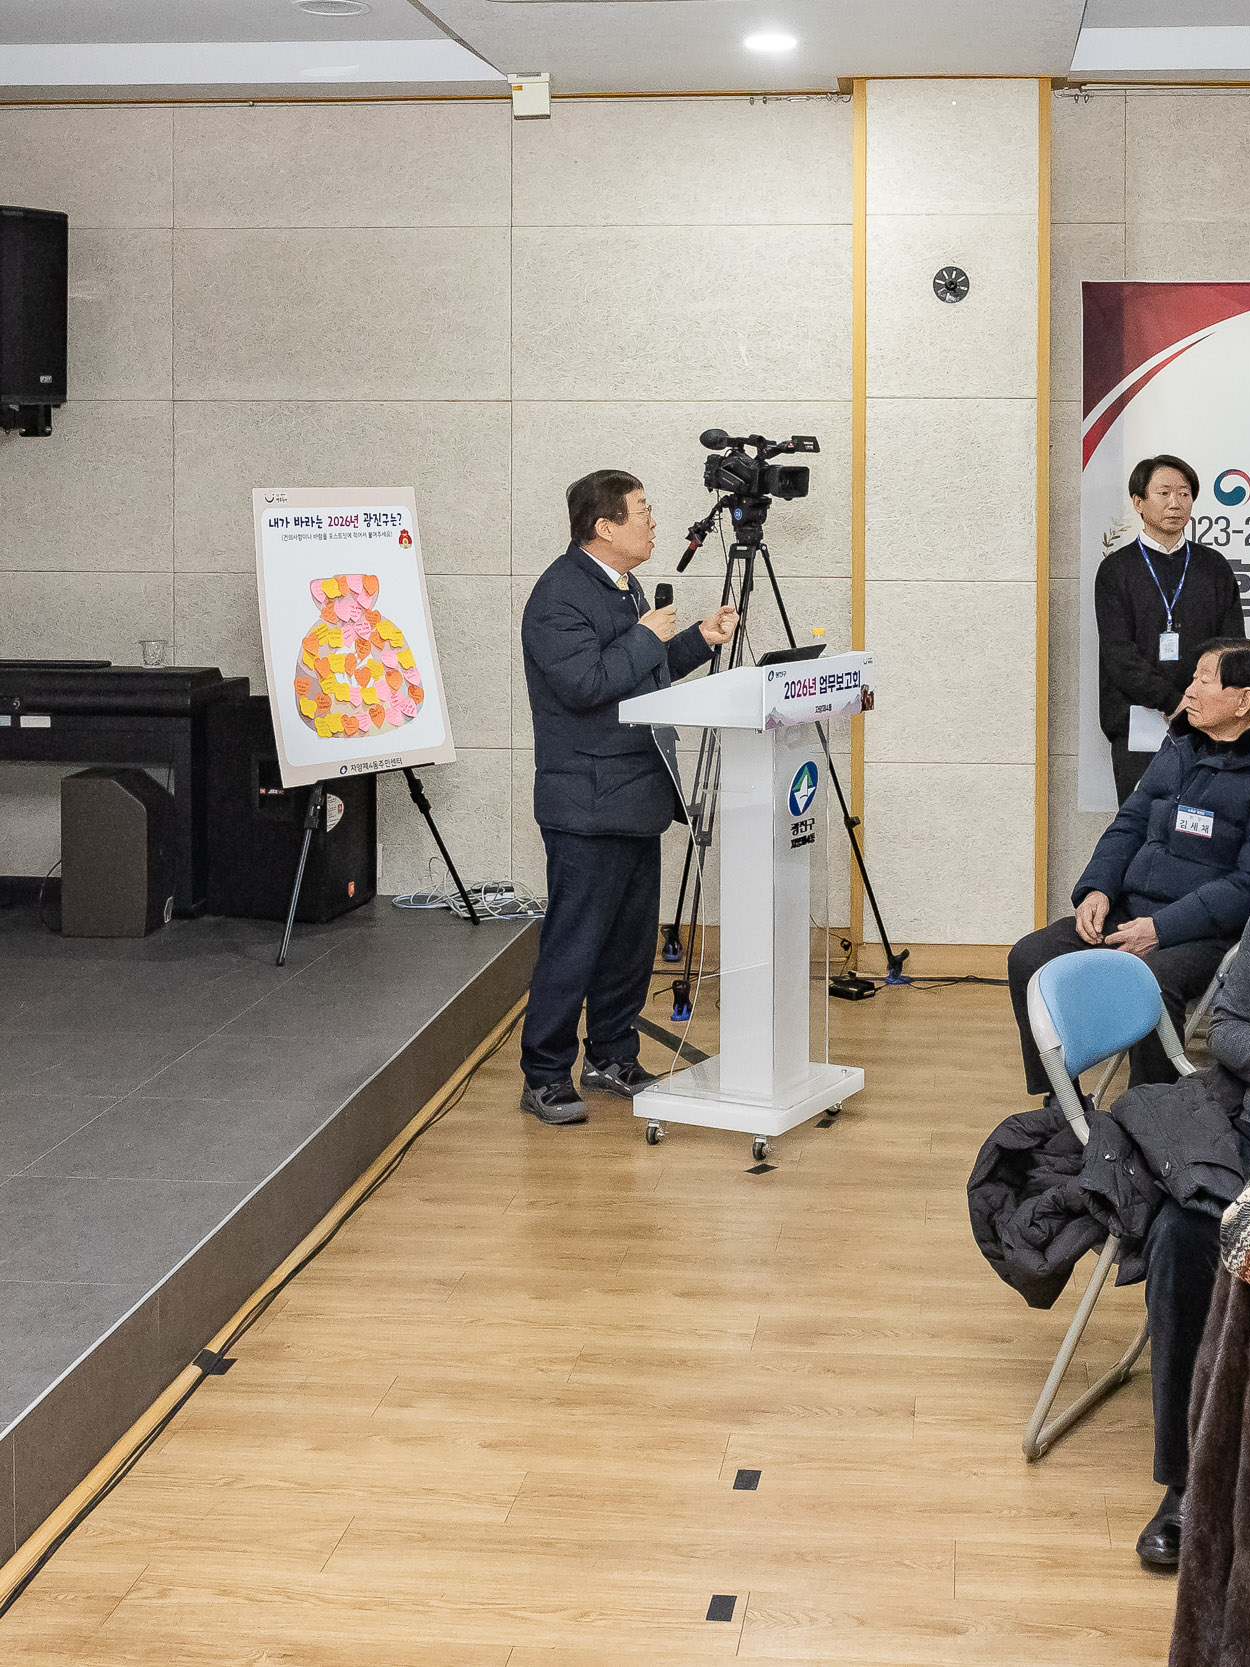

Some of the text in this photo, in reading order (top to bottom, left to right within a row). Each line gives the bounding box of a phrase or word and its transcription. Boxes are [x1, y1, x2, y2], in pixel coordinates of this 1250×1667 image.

[268, 512, 402, 529] 내가 바라는 2026년 광진구는?
[784, 670, 861, 700] 2026년 업무보고회
[790, 818, 815, 835] 광진구
